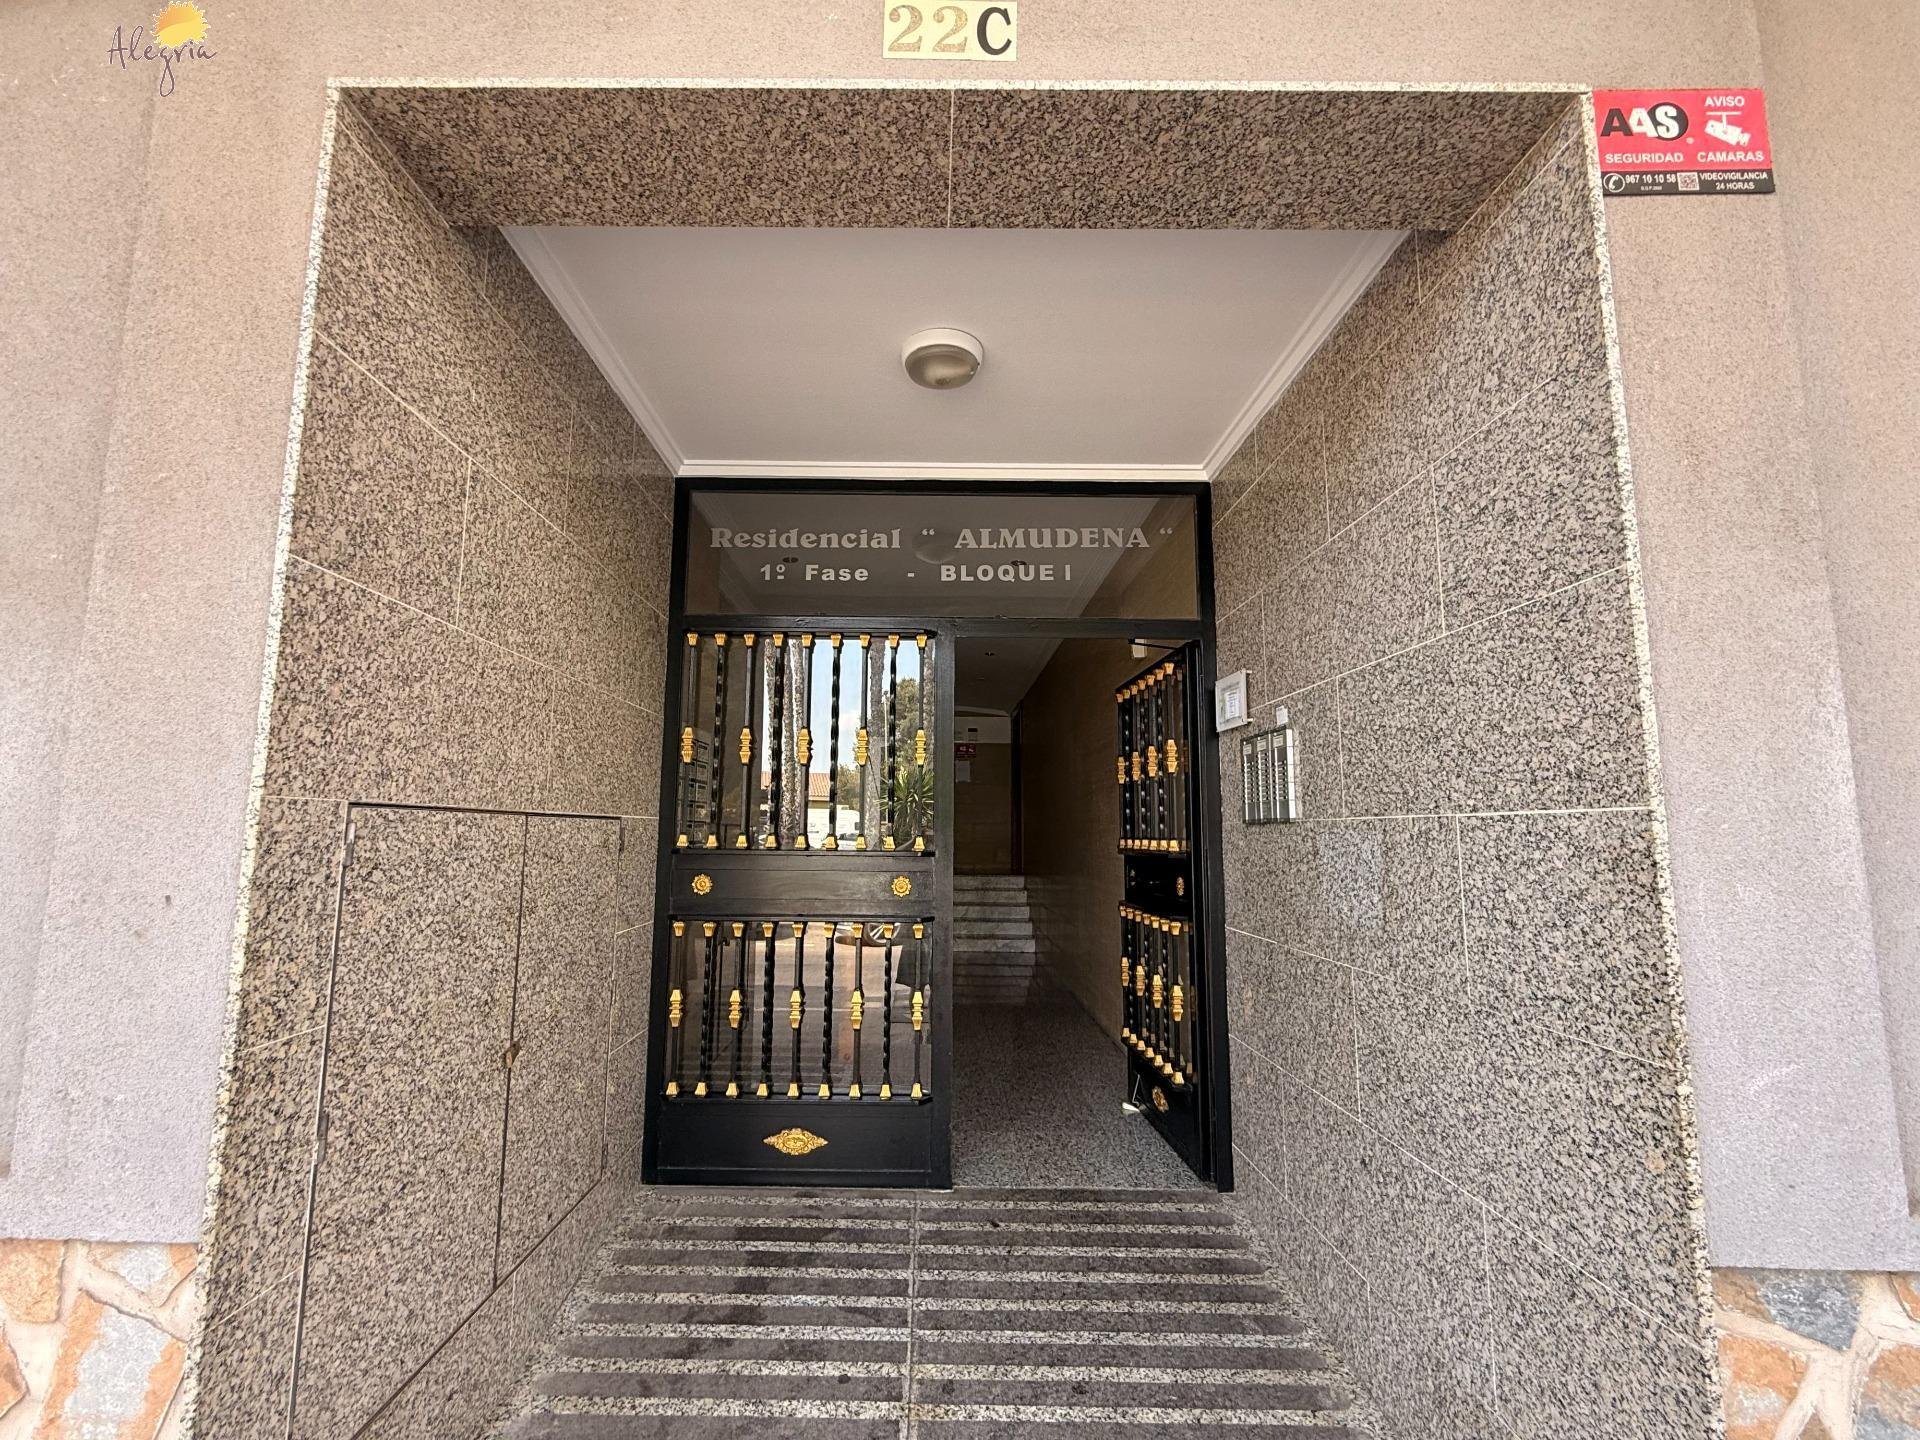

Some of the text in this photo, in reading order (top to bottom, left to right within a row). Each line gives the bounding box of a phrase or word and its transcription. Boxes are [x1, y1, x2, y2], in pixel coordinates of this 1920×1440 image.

[1704, 95, 1745, 107] AVISO
[1606, 152, 1684, 164] SEGURIDAD
[1697, 151, 1764, 162] CAMARAS
[1625, 173, 1676, 183] 967 10 10 58
[1700, 171, 1768, 180] VIDEOVIGILANCIA
[1716, 181, 1755, 190] 24 HORAS
[710, 527, 901, 549] Residencial
[954, 527, 1150, 549] ALMUDENA
[805, 564, 869, 582] Fase
[940, 564, 1055, 583] BLOQUE
